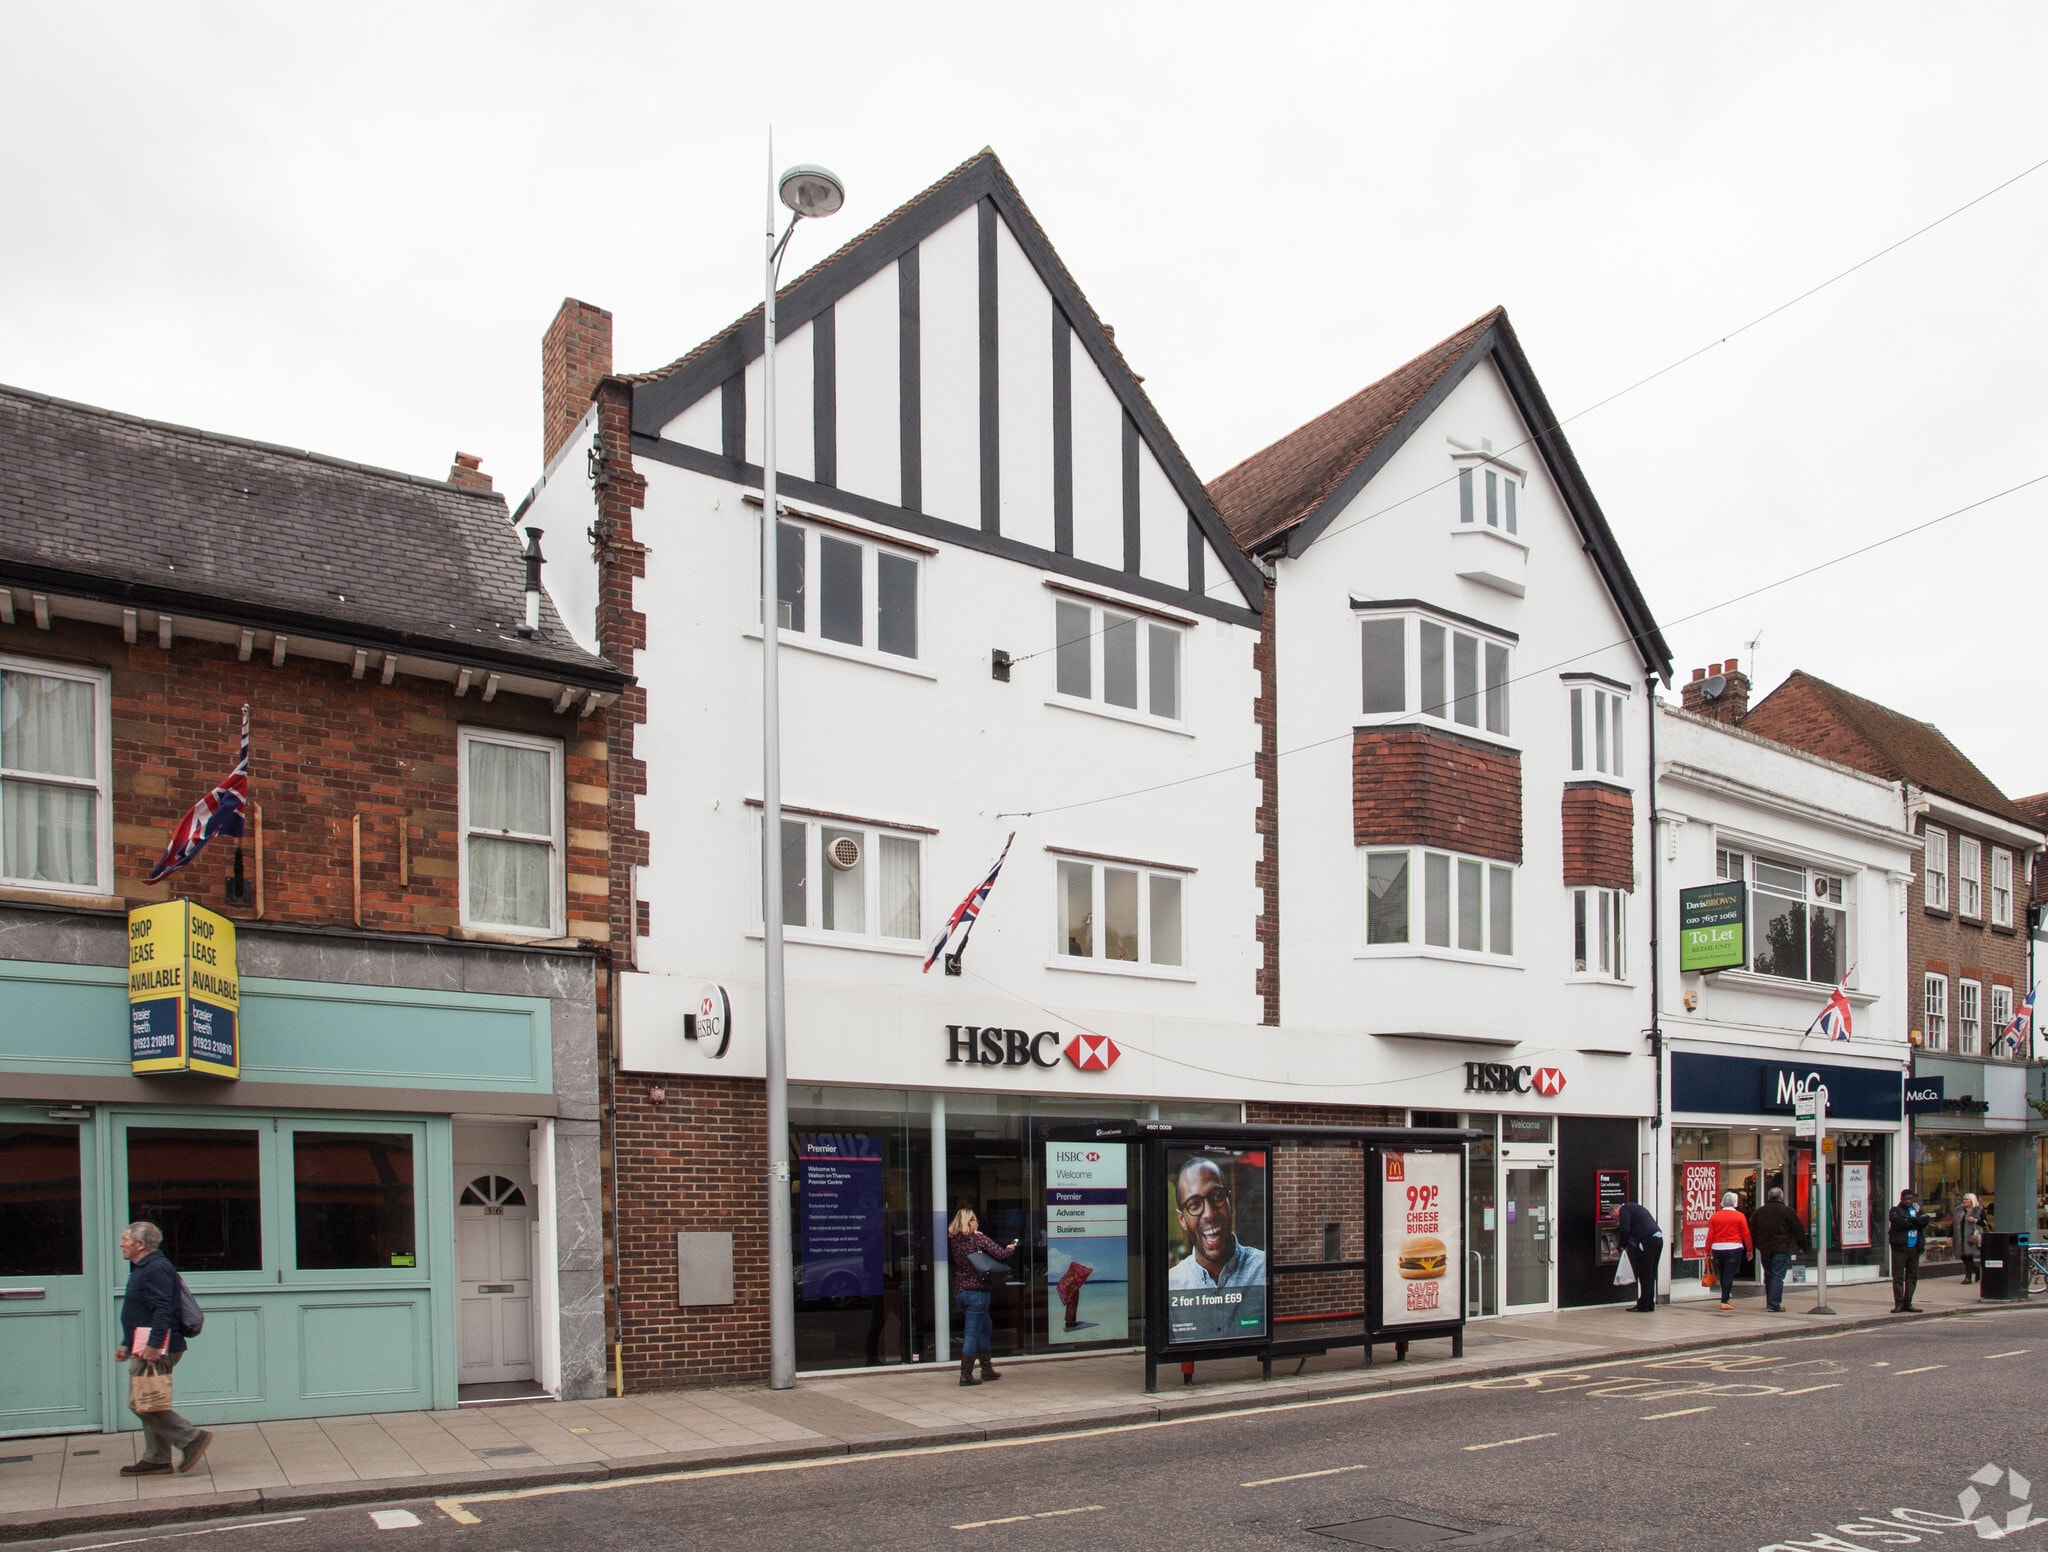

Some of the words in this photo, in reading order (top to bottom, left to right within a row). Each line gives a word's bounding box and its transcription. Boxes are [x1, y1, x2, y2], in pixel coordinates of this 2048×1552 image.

[1701, 914, 1718, 923] 7637
[1720, 910, 1737, 920] 1066
[131, 919, 152, 940] SHOP
[192, 916, 214, 941] SHOP
[1690, 932, 1708, 944] To
[1712, 929, 1734, 942] Let
[131, 943, 154, 964] LEASE
[192, 941, 216, 966] LEASE
[1692, 945, 1714, 953] RETAIL
[131, 968, 181, 992] AVAILABLE
[192, 970, 237, 1001] AVAILABLE
[132, 1008, 151, 1021] brasier
[193, 1004, 213, 1022] brasier
[134, 1021, 150, 1034] freeth
[193, 1020, 212, 1036] freeth
[697, 1017, 720, 1038] HSBC
[134, 1036, 150, 1049] 01923
[151, 1034, 174, 1047] 210810
[193, 1036, 211, 1050] 01923
[212, 1041, 232, 1055] 210810
[946, 1025, 1060, 1068] HSBC
[1464, 1062, 1531, 1093] HSBC
[1906, 1089, 1938, 1101] M&Co.
[1511, 1120, 1540, 1129] Welcome
[808, 1144, 837, 1153] Premier
[1057, 1152, 1084, 1162] HSBC
[1056, 1170, 1092, 1179] Welcome
[1687, 1167, 1715, 1177] CLOSING
[1687, 1178, 1715, 1191] DOWN
[1407, 1185, 1438, 1210] 99p
[1687, 1190, 1715, 1211] SALE
[1850, 1200, 1862, 1208] NEW
[1407, 1212, 1438, 1222] CHEESE
[1687, 1211, 1704, 1221] NOW
[1850, 1210, 1862, 1218] SALE
[1407, 1223, 1438, 1234] BURGER
[1848, 1220, 1864, 1229] STOCK
[1407, 1282, 1439, 1297] SAVER
[1171, 1297, 1178, 1307] 2
[1180, 1296, 1194, 1306] for
[1196, 1296, 1200, 1305] 1
[1202, 1294, 1223, 1305] from
[1225, 1293, 1242, 1303] £69
[1407, 1294, 1439, 1311] MENU
[1469, 1374, 1785, 1401] STOP
